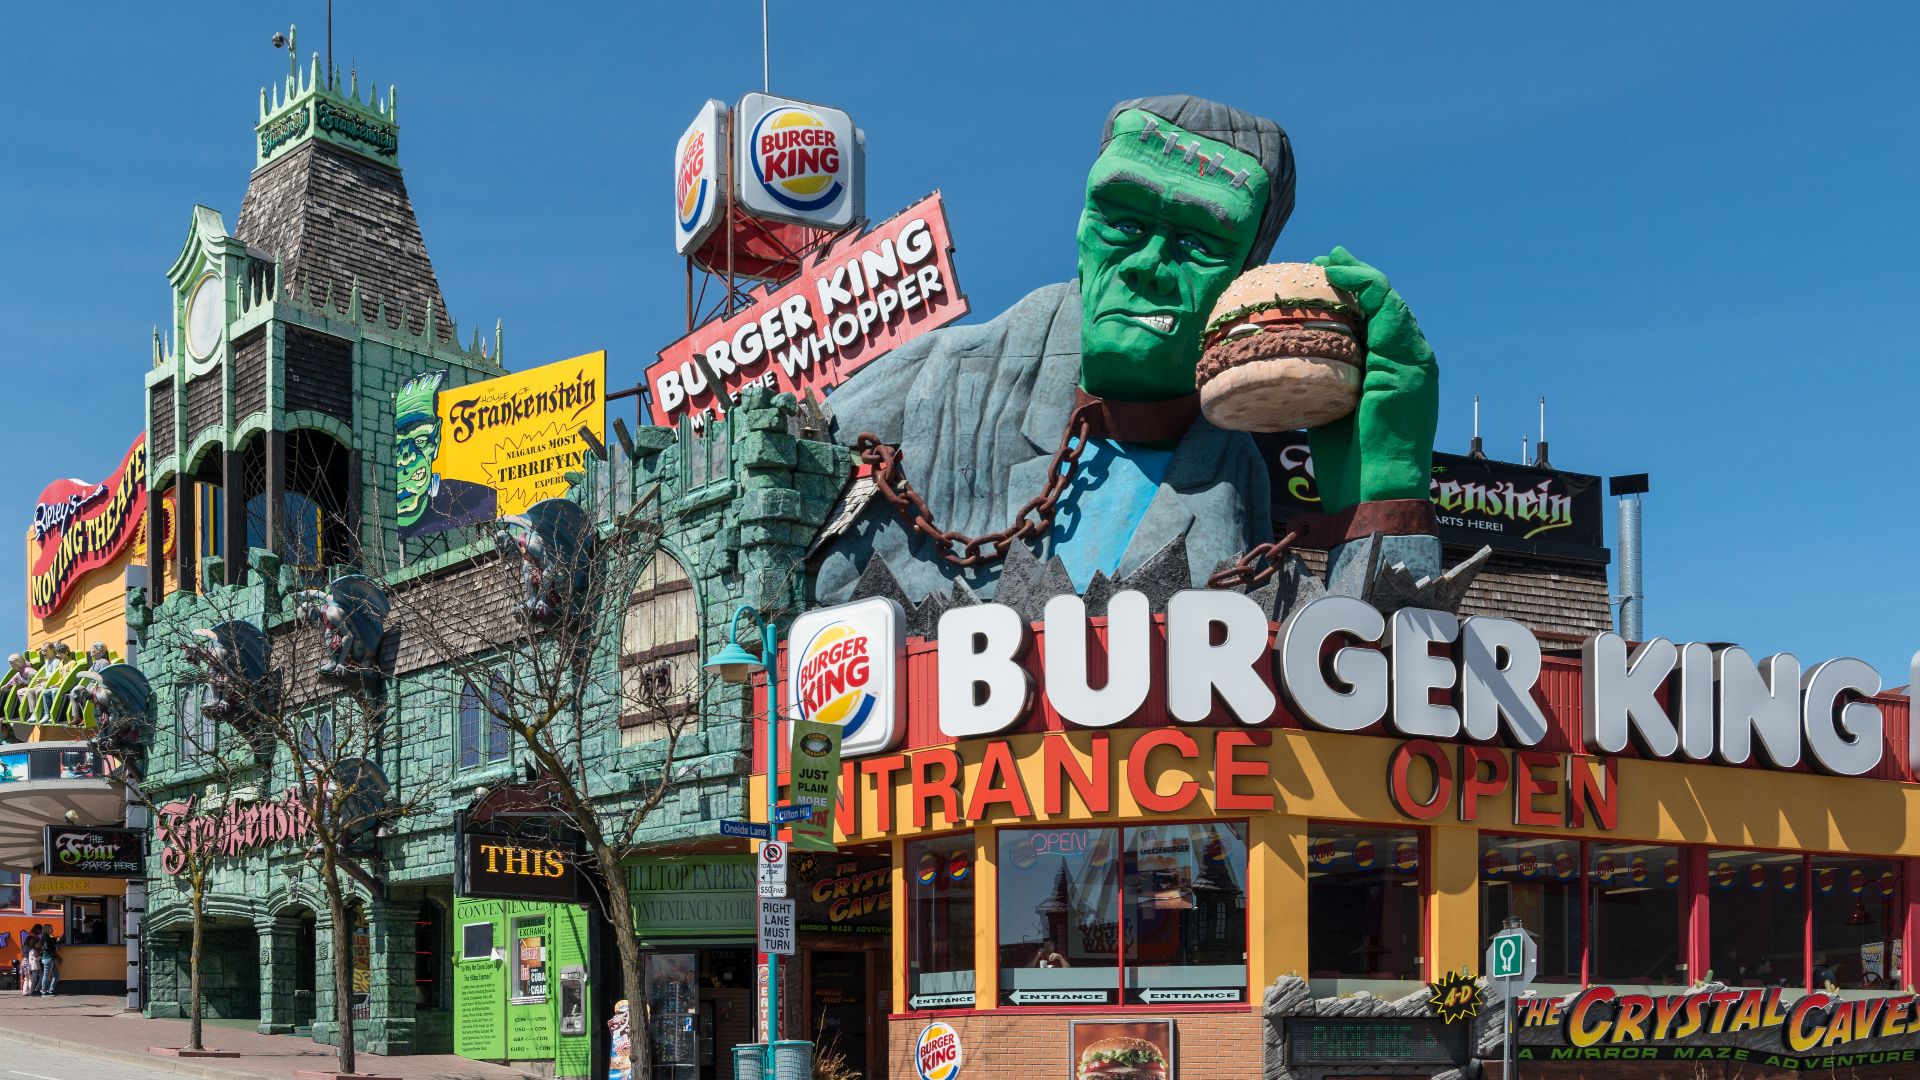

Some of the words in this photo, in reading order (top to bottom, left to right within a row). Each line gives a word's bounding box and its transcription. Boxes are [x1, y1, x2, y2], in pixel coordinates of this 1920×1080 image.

[761, 129, 836, 155] BURGER
[762, 147, 840, 183] KING
[656, 294, 812, 414] BURGER
[817, 218, 933, 315] KING
[778, 265, 943, 377] WHOPPER
[450, 369, 596, 443] Frankenstein
[506, 443, 546, 461] NIAGARAS
[548, 433, 578, 450] MOST
[32, 520, 83, 607] MOVING
[86, 441, 146, 552] THEATE
[1435, 516, 1463, 527] ARTS
[1468, 519, 1504, 532] HERE!
[800, 636, 868, 692] BURGER
[801, 655, 870, 720] KING
[937, 589, 1548, 746] BURGER
[1582, 631, 1883, 777] KING
[799, 768, 829, 780] JUST
[798, 782, 828, 794] PLAIN
[1387, 740, 1618, 830] OPEN
[797, 795, 827, 807] MORE
[779, 807, 798, 820] Clifton
[799, 807, 810, 817] Hill
[87, 834, 104, 844] THE
[724, 823, 748, 835] Oneida
[750, 824, 766, 837] Lane
[56, 833, 120, 865] Fear
[1031, 832, 1087, 852] OPEN
[113, 861, 138, 871] HERE
[480, 845, 564, 878] THIS
[625, 865, 688, 890] HILLTOP
[693, 864, 757, 890] EXPRESS
[760, 886, 772, 894] $50
[457, 900, 543, 920] CONVENIENCE
[632, 899, 712, 921] ONVENIENCE
[716, 898, 755, 920] STORE
[763, 903, 791, 914] RIGHT
[765, 915, 790, 926] LANE
[800, 924, 828, 932] MIRROR
[764, 927, 790, 938] MUST
[765, 939, 790, 951] TURN
[916, 995, 975, 1005] ENTRANCE
[1020, 993, 1104, 1001] ENTRANCE
[1150, 991, 1236, 1000] ENTRANCE
[1444, 985, 1472, 1006] 4-D
[1569, 985, 1788, 1047] CRYSTAL
[919, 1033, 955, 1059] BURGER
[921, 1046, 957, 1074] KING
[1518, 1048, 1534, 1059] A
[1551, 1046, 1658, 1059] MIRROR
[1674, 1046, 1751, 1060] MAZE
[1764, 1050, 1914, 1069] ADVENTURE
